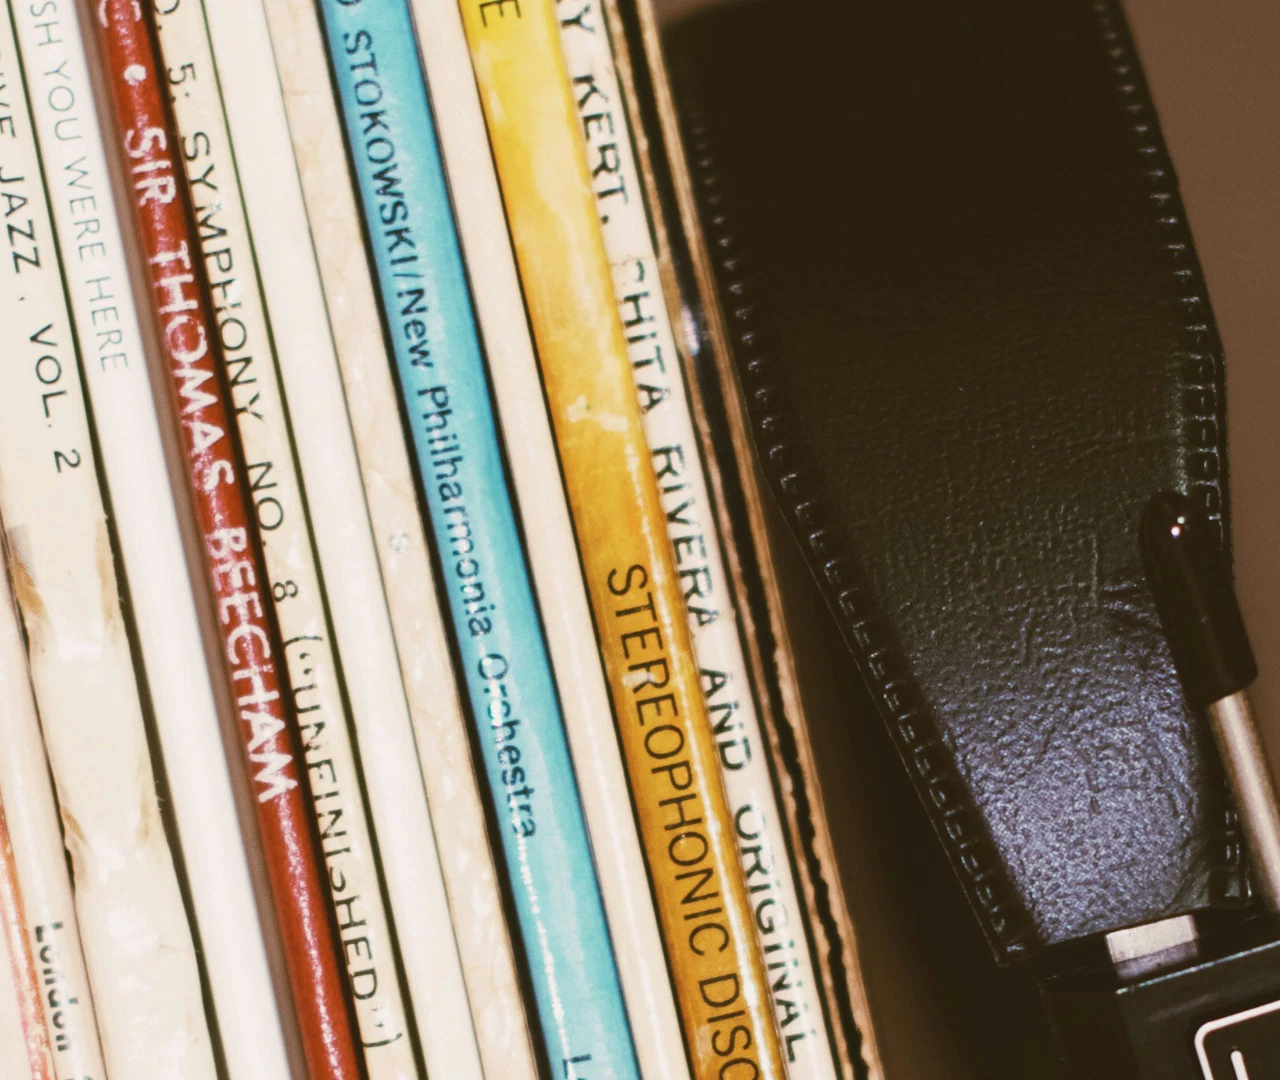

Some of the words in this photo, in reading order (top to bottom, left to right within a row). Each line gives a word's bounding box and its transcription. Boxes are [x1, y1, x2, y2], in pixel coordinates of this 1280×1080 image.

[42, 61, 82, 144] YOU
[122, 123, 179, 209] SIR
[60, 156, 105, 262] WERE
[27, 324, 71, 430] VOL.
[51, 446, 81, 475] 2
[82, 275, 128, 375] HERE
[145, 239, 237, 494] THOMAS
[179, 130, 264, 427] SYMPHONY
[244, 460, 288, 548] NO.
[269, 579, 300, 605] 8
[417, 384, 499, 639] Philharmonia
[475, 652, 543, 840] Orchestra
[558, 4, 596, 39] Y
[610, 260, 673, 413] HITA
[652, 443, 721, 630] RIVERA
[700, 662, 753, 774] AND
[731, 801, 821, 1064] ORIGINAL
[202, 524, 300, 804] BEECHAM
[605, 561, 731, 958] STEREOPHONIC
[32, 921, 87, 1053] London
